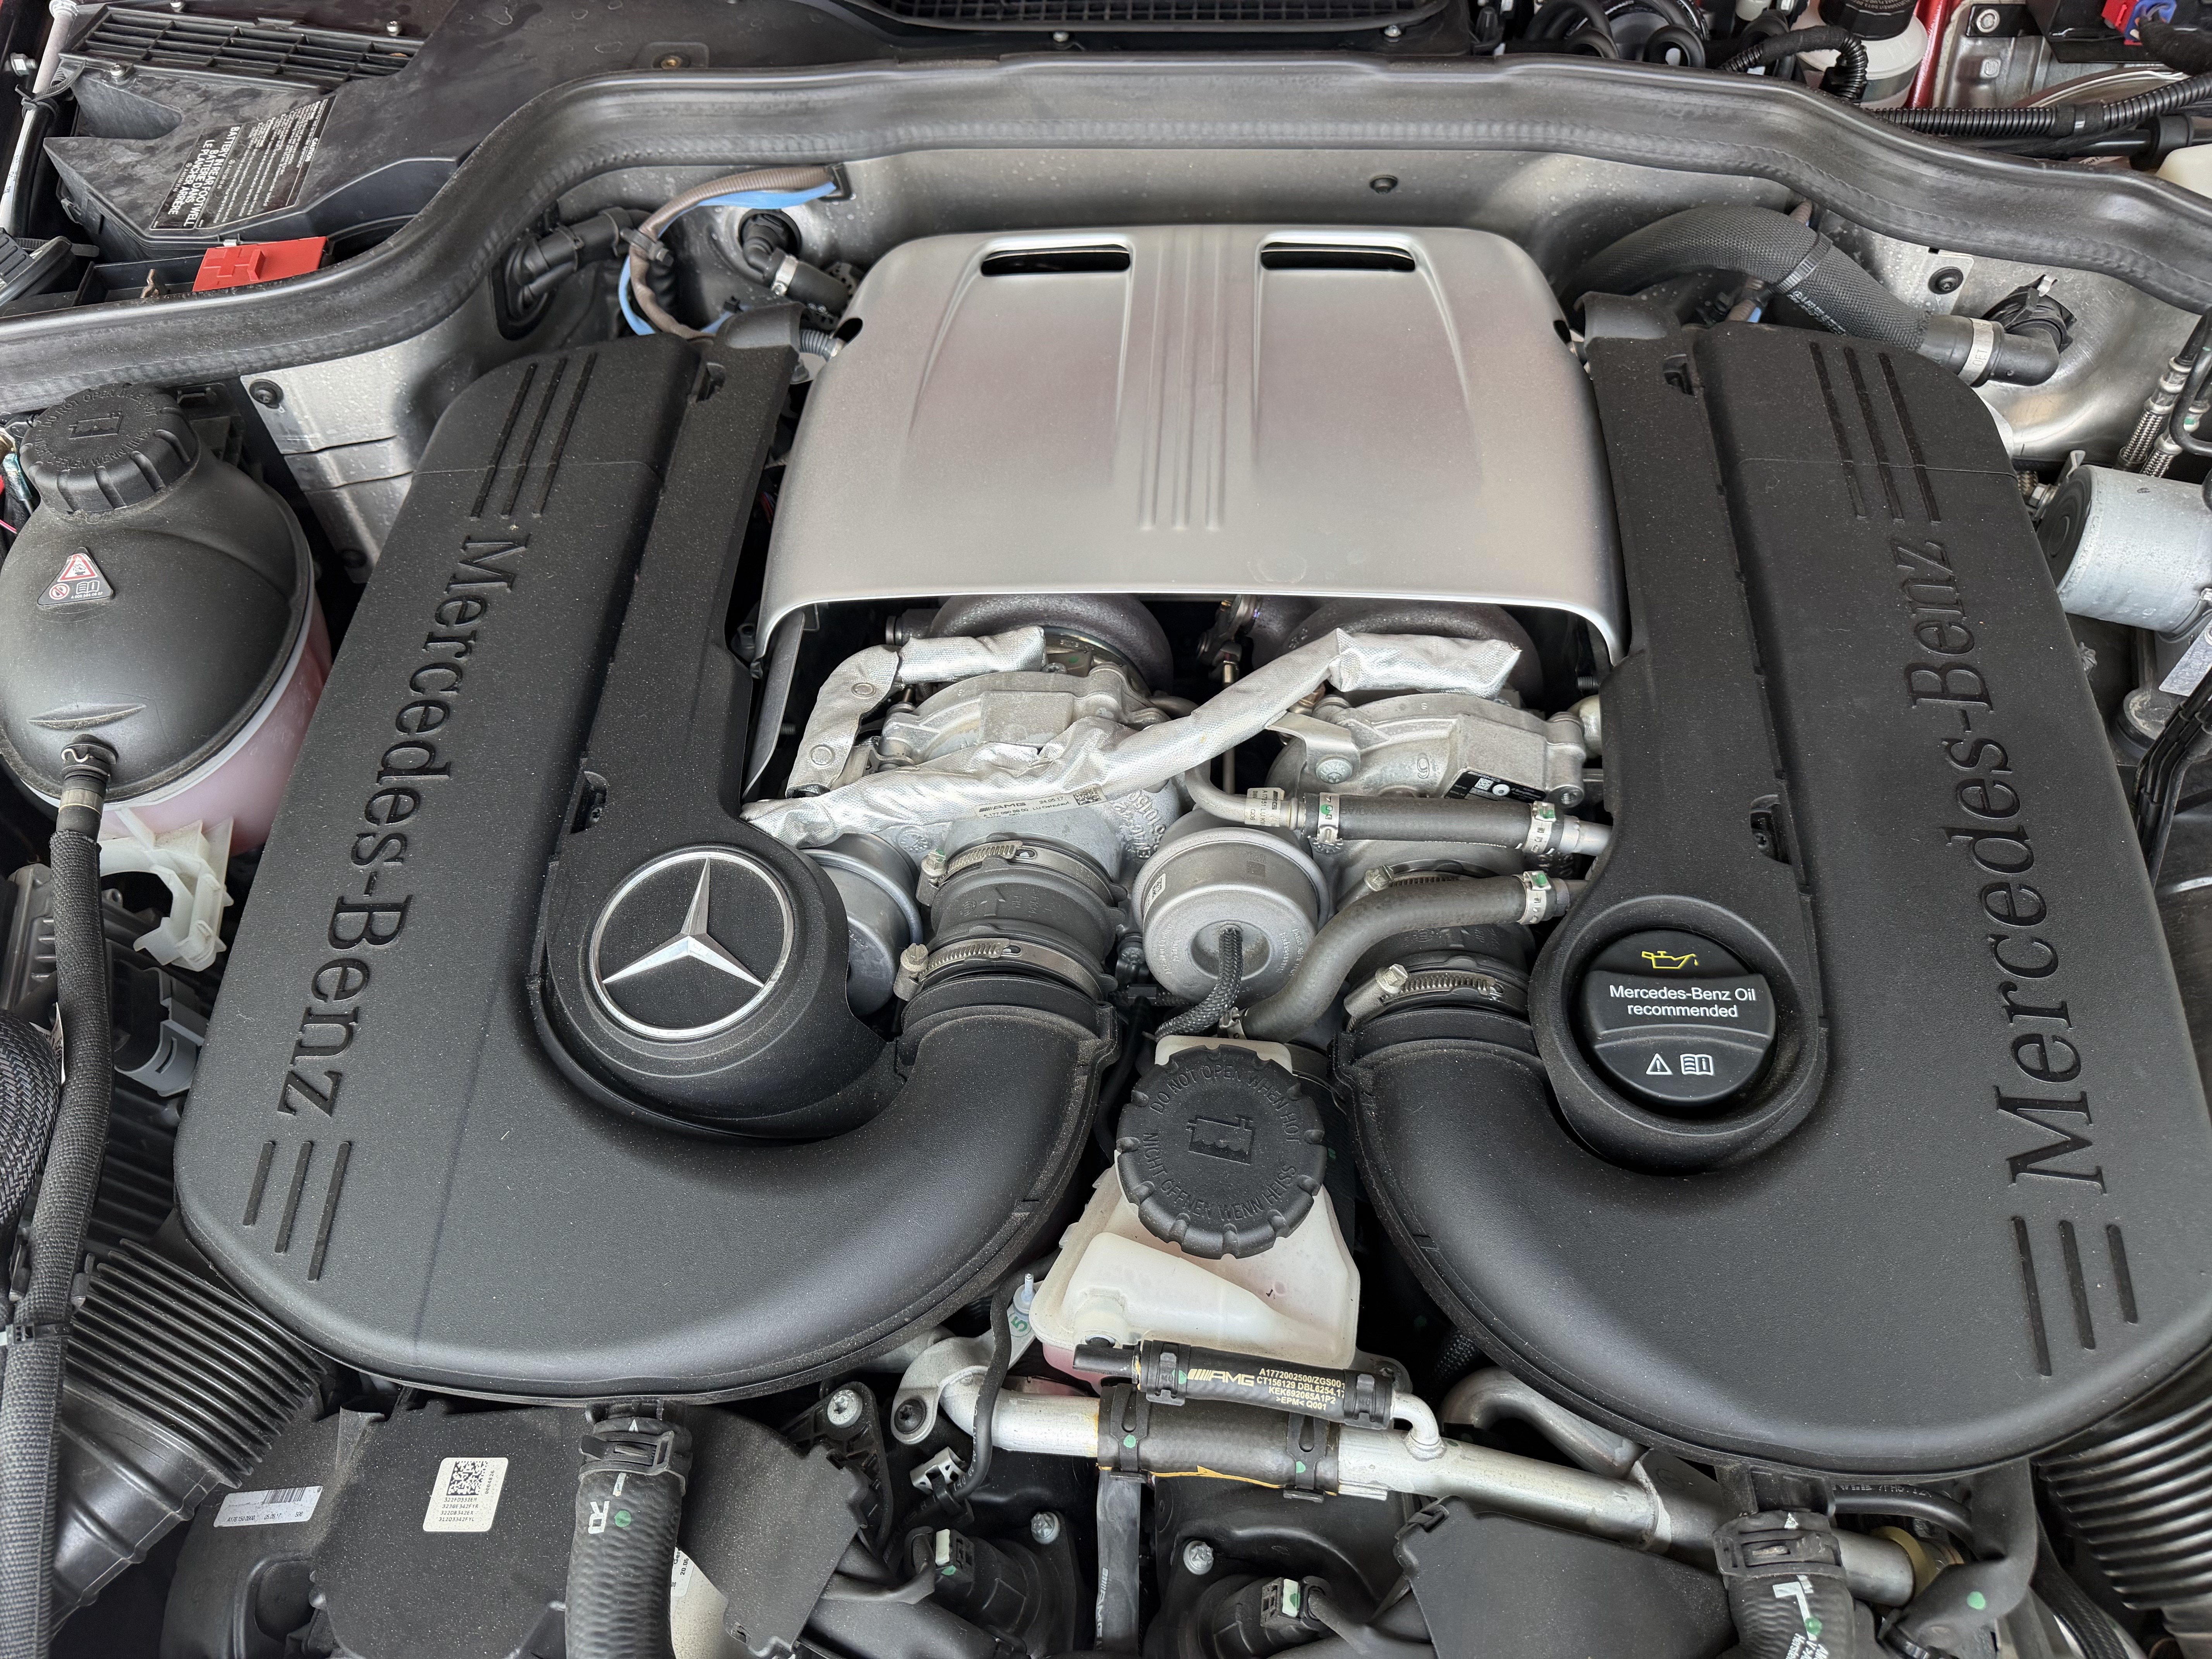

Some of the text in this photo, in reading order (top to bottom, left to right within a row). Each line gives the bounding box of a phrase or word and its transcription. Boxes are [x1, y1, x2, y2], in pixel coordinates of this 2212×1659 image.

[216, 126, 241, 158] BATTERY
[304, 137, 319, 162] CAUTION
[213, 158, 225, 166] IN
[167, 139, 215, 215] LE PLANCHER ARRIÈRE
[184, 149, 219, 203] BATTERIE DANS
[202, 165, 221, 185] REAR
[182, 185, 211, 227] FOOTWELL
[55, 400, 79, 415] NOT
[979, 802, 1025, 812] AMG
[277, 533, 531, 1117] Mercedes-Benz
[1891, 538, 2107, 1195] Mercedes-Benz
[1609, 985, 1756, 1001] Mercedes-Benz Oil
[1627, 1004, 1738, 1018] recommended
[1150, 1092, 1171, 1115] DO
[1166, 1067, 1197, 1094] NOT
[1201, 1064, 1241, 1082] OPEN
[1280, 1112, 1300, 1145] HOT
[1142, 1132, 1168, 1177] NICHT
[1217, 1197, 1264, 1221] WENN
[1261, 1165, 1297, 1205] HEISS
[1011, 1316, 1027, 1332] 5
[1187, 1369, 1255, 1387] AMG
[1256, 1376, 1295, 1389] CT156129
[1268, 1386, 1336, 1404] KEK692065A1P2
[1276, 1396, 1327, 1410] >EPM< Q001
[587, 1500, 610, 1534] R
